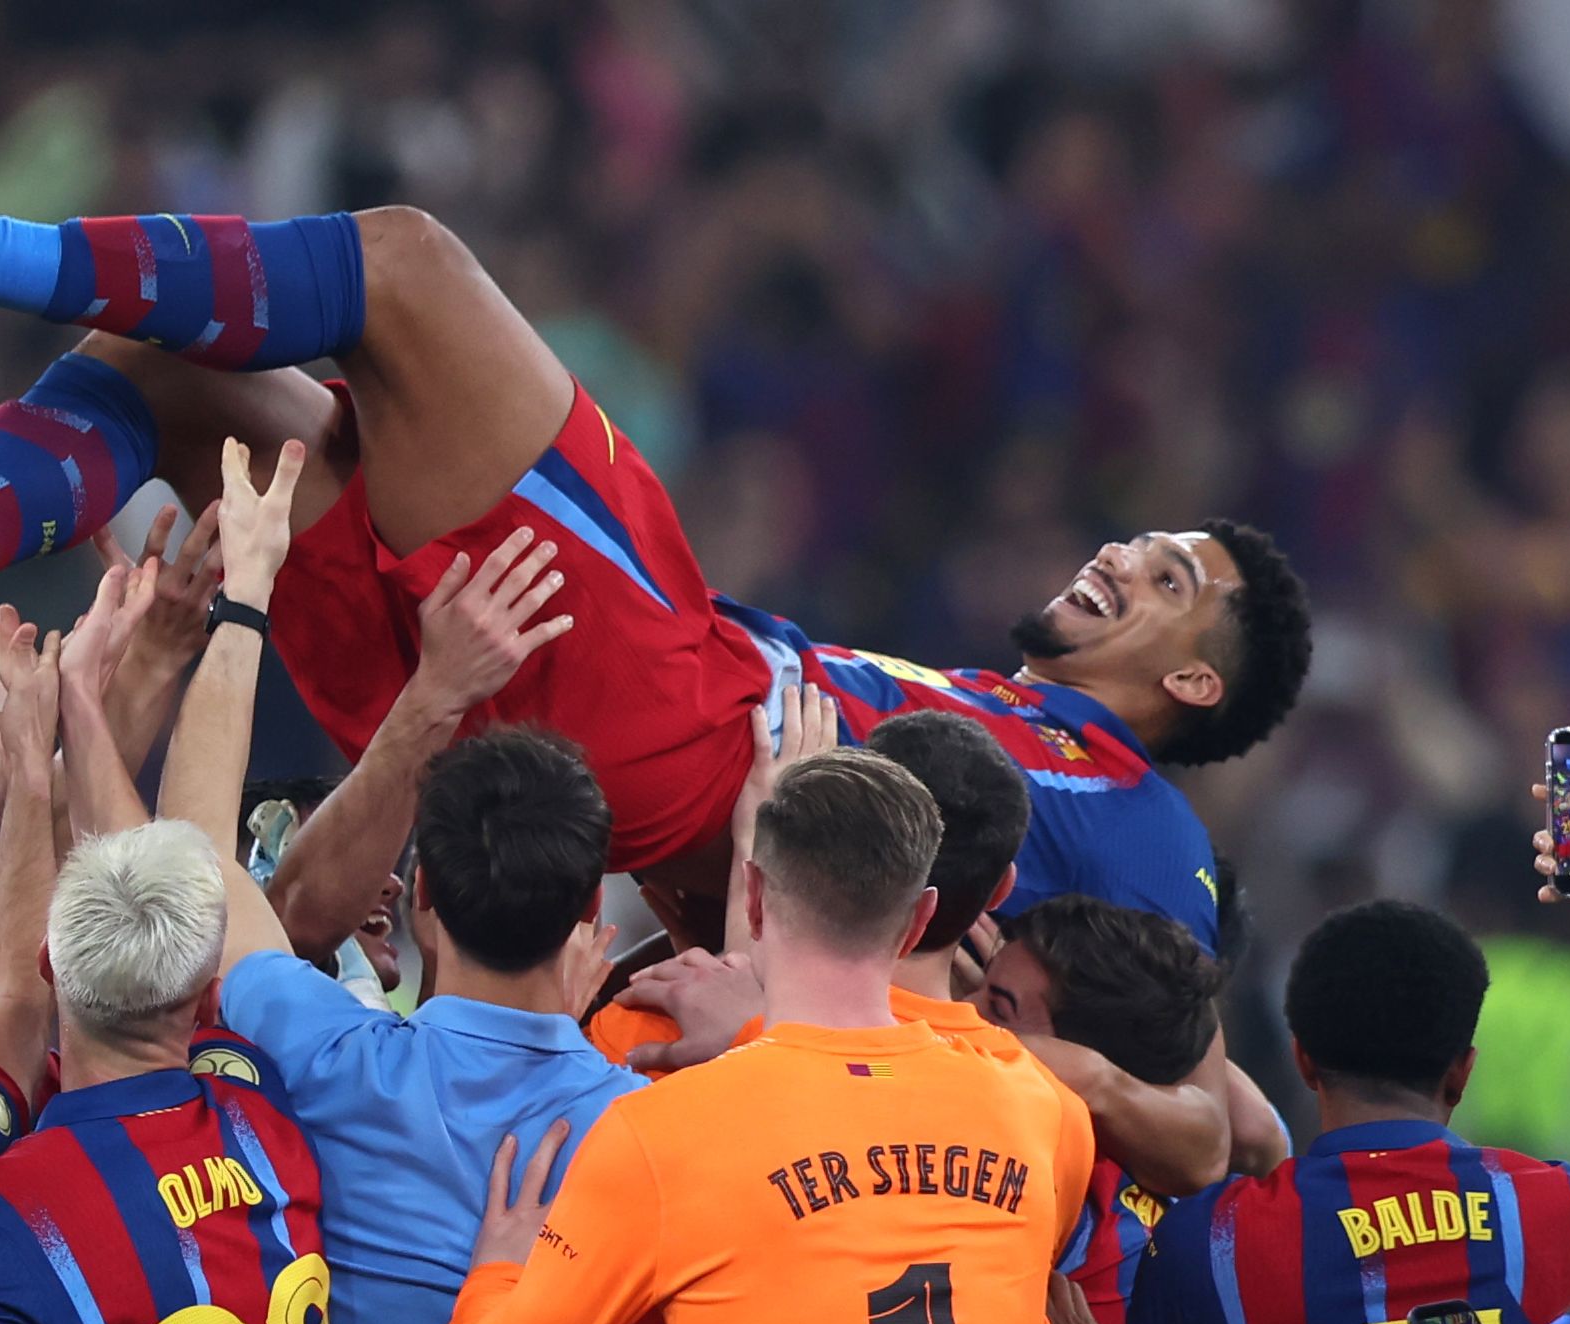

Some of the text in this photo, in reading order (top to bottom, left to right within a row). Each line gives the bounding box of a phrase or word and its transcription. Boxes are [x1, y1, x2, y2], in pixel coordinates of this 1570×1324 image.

[157, 1156, 263, 1229] OLMO
[768, 1144, 1029, 1222] TER STEGEN
[1338, 1188, 1492, 1260] BALDE
